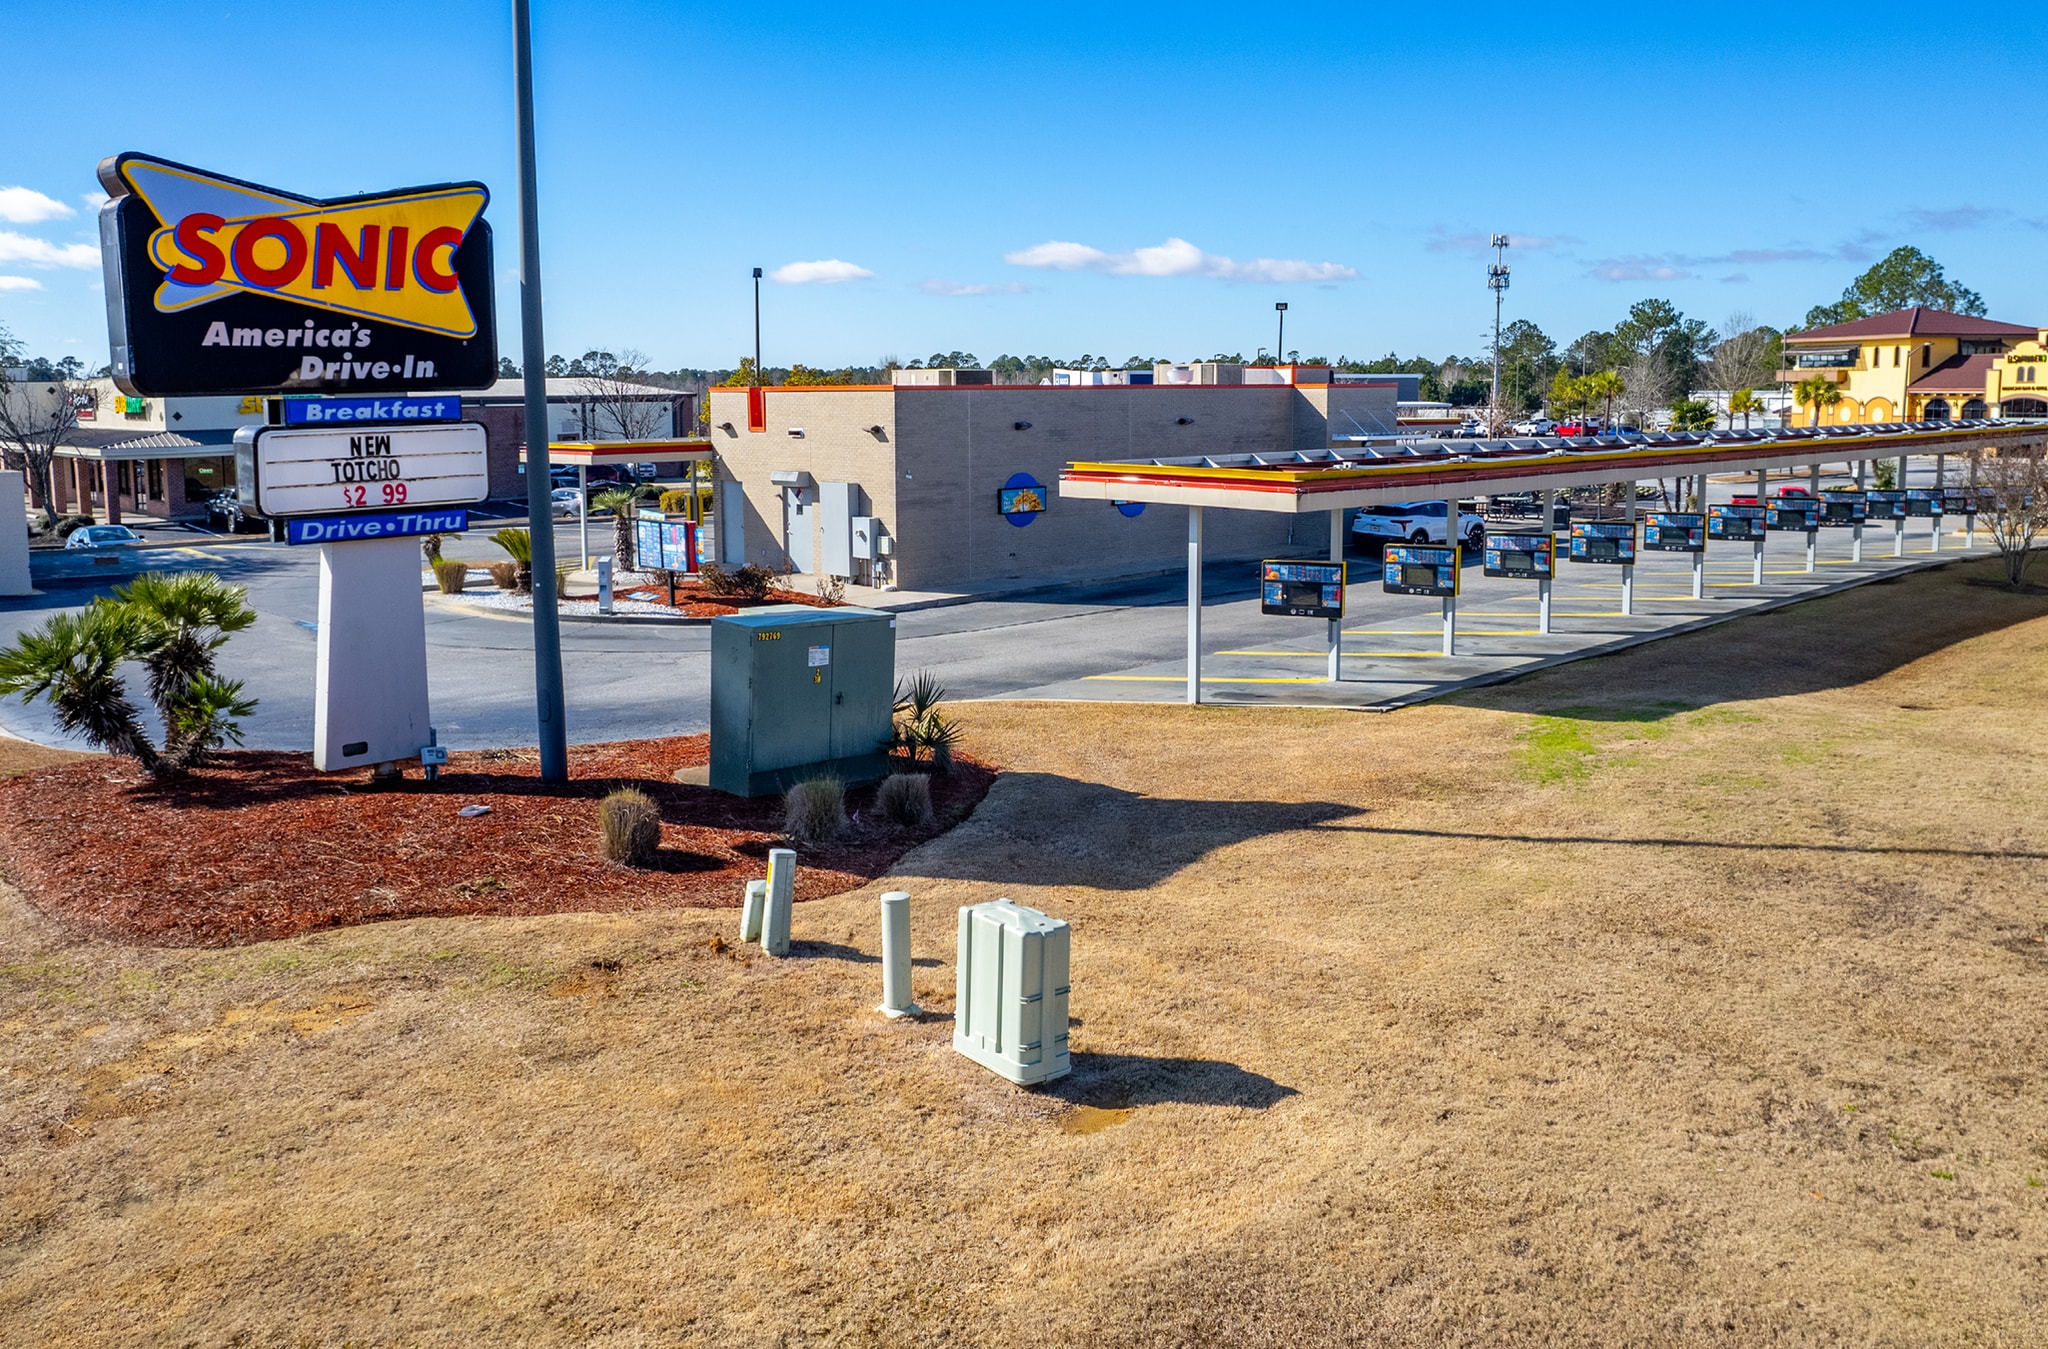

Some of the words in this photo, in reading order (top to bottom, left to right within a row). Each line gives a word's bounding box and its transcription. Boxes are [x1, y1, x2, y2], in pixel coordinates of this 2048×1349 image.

[167, 212, 463, 292] SONIC
[201, 319, 372, 348] America's
[306, 401, 445, 421] Breakfast
[350, 435, 391, 457] NEW
[331, 459, 400, 482] TOTCHO
[382, 483, 407, 504] 99
[758, 631, 781, 641] 792769
